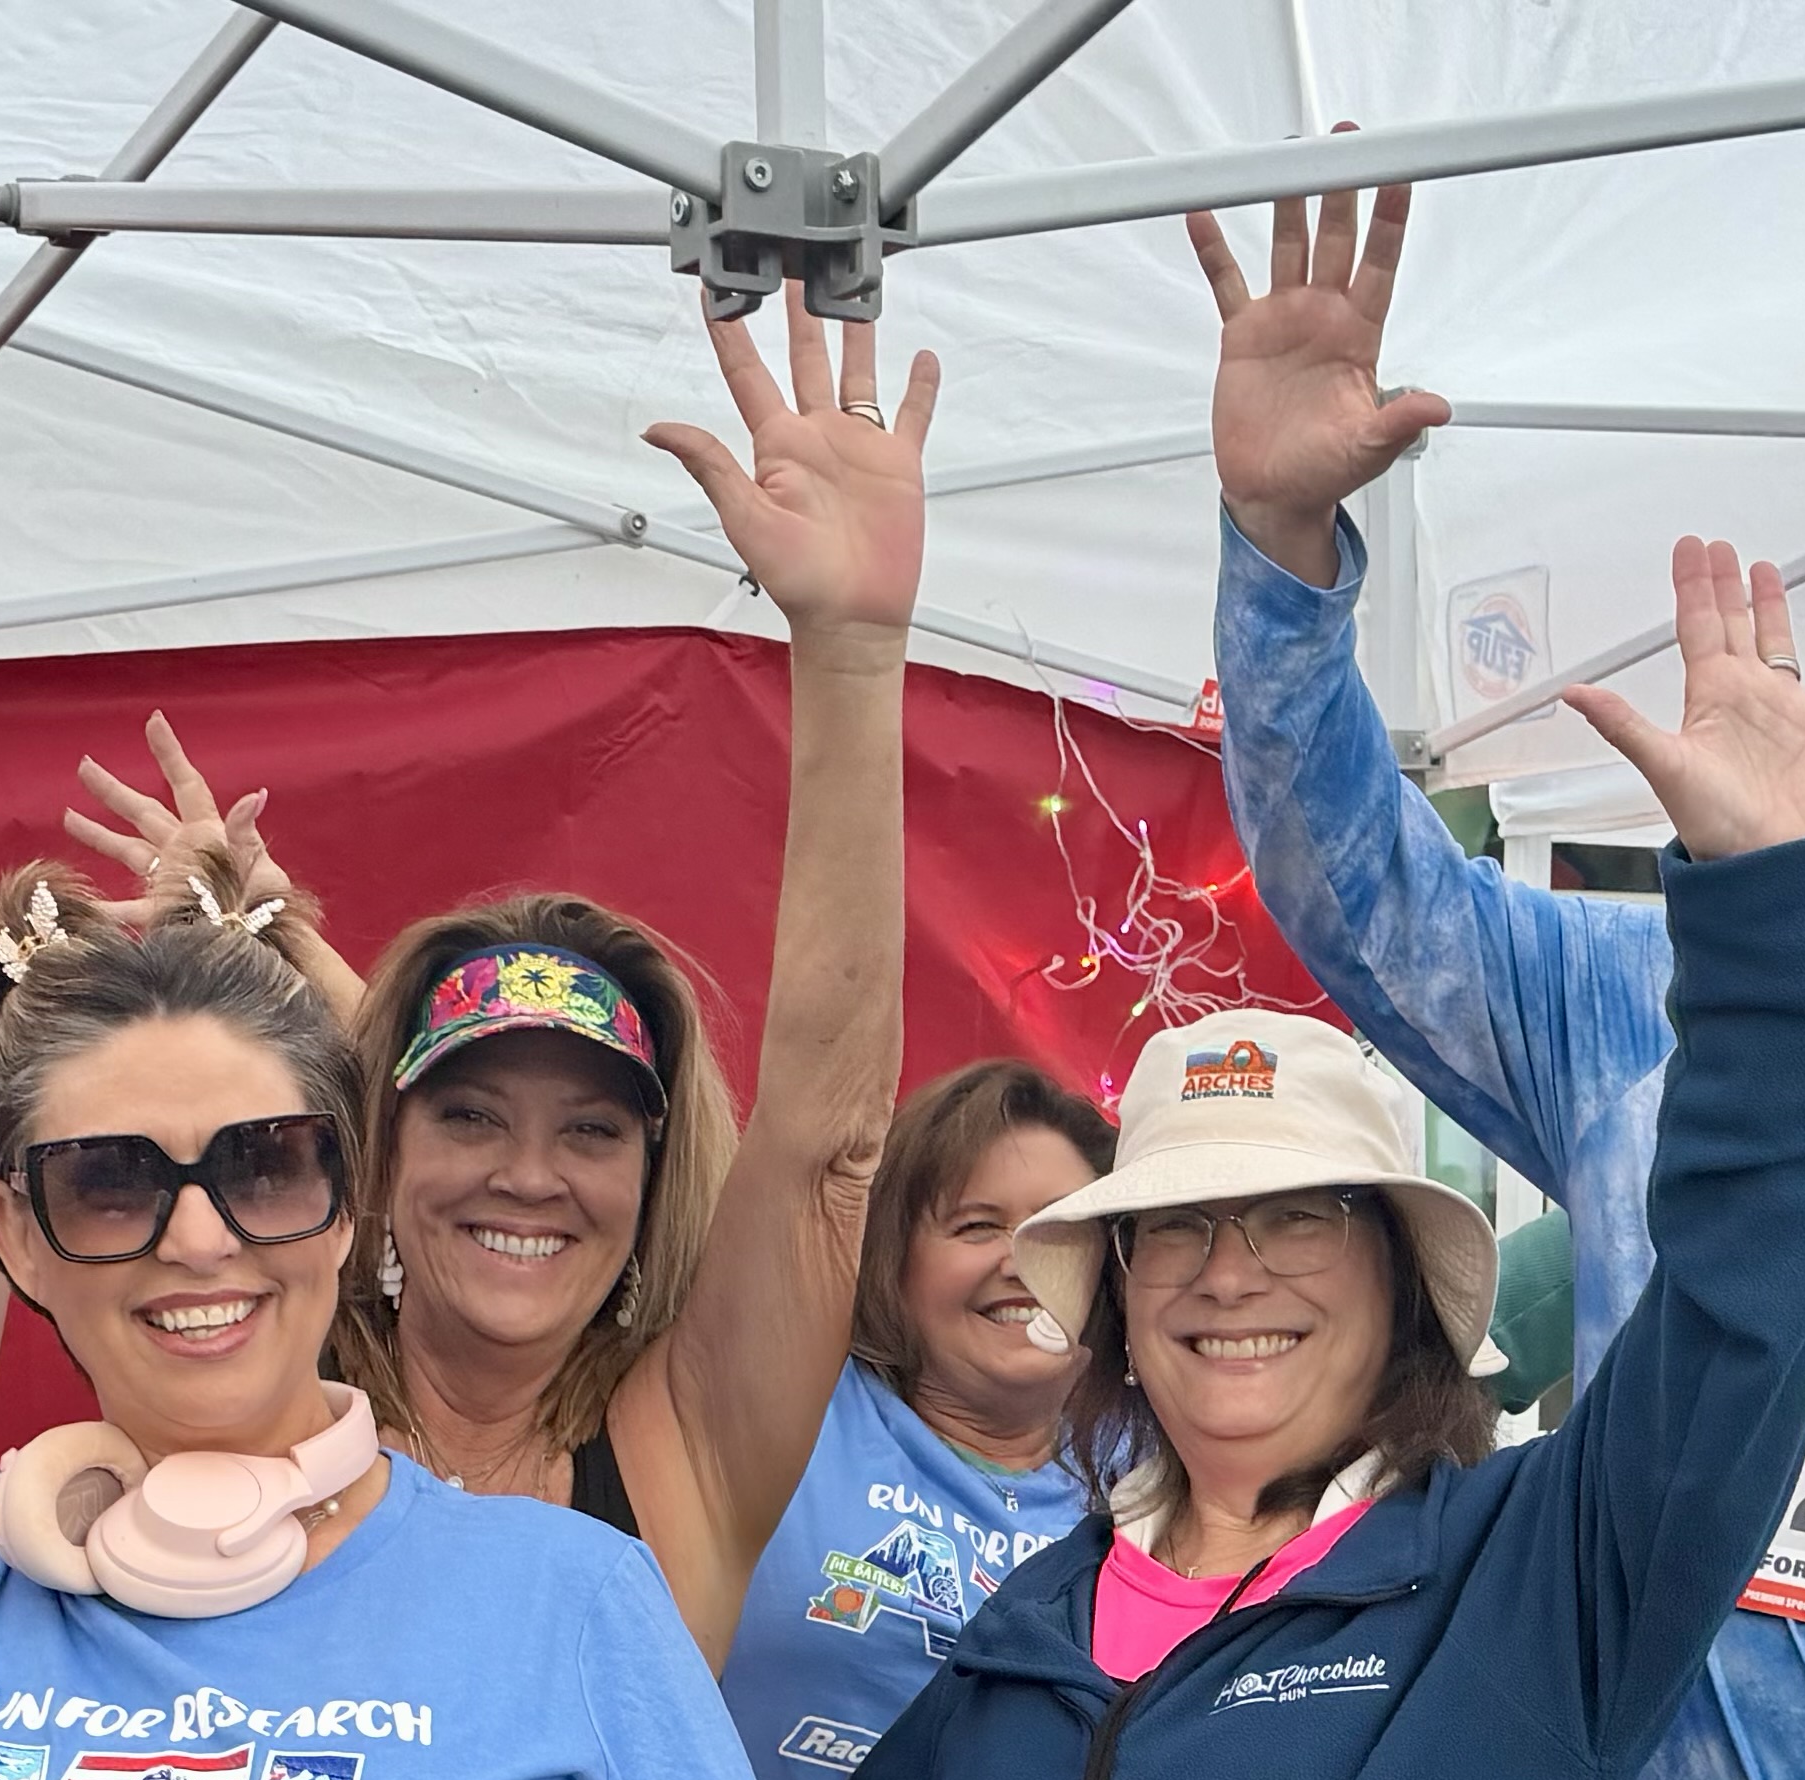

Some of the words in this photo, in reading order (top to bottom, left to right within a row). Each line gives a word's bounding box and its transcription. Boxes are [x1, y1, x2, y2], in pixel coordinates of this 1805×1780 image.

[1182, 1075, 1274, 1093] ARCHES
[868, 1484, 943, 1528] RUN
[953, 1512, 1009, 1568] FOR
[829, 1556, 851, 1573] THE
[854, 1562, 905, 1595] BATTERY
[1279, 1654, 1386, 1690] Chocolate
[1279, 1689, 1307, 1703] RUN
[55, 1696, 167, 1738] FOR
[169, 1686, 433, 1746] RESEARCH
